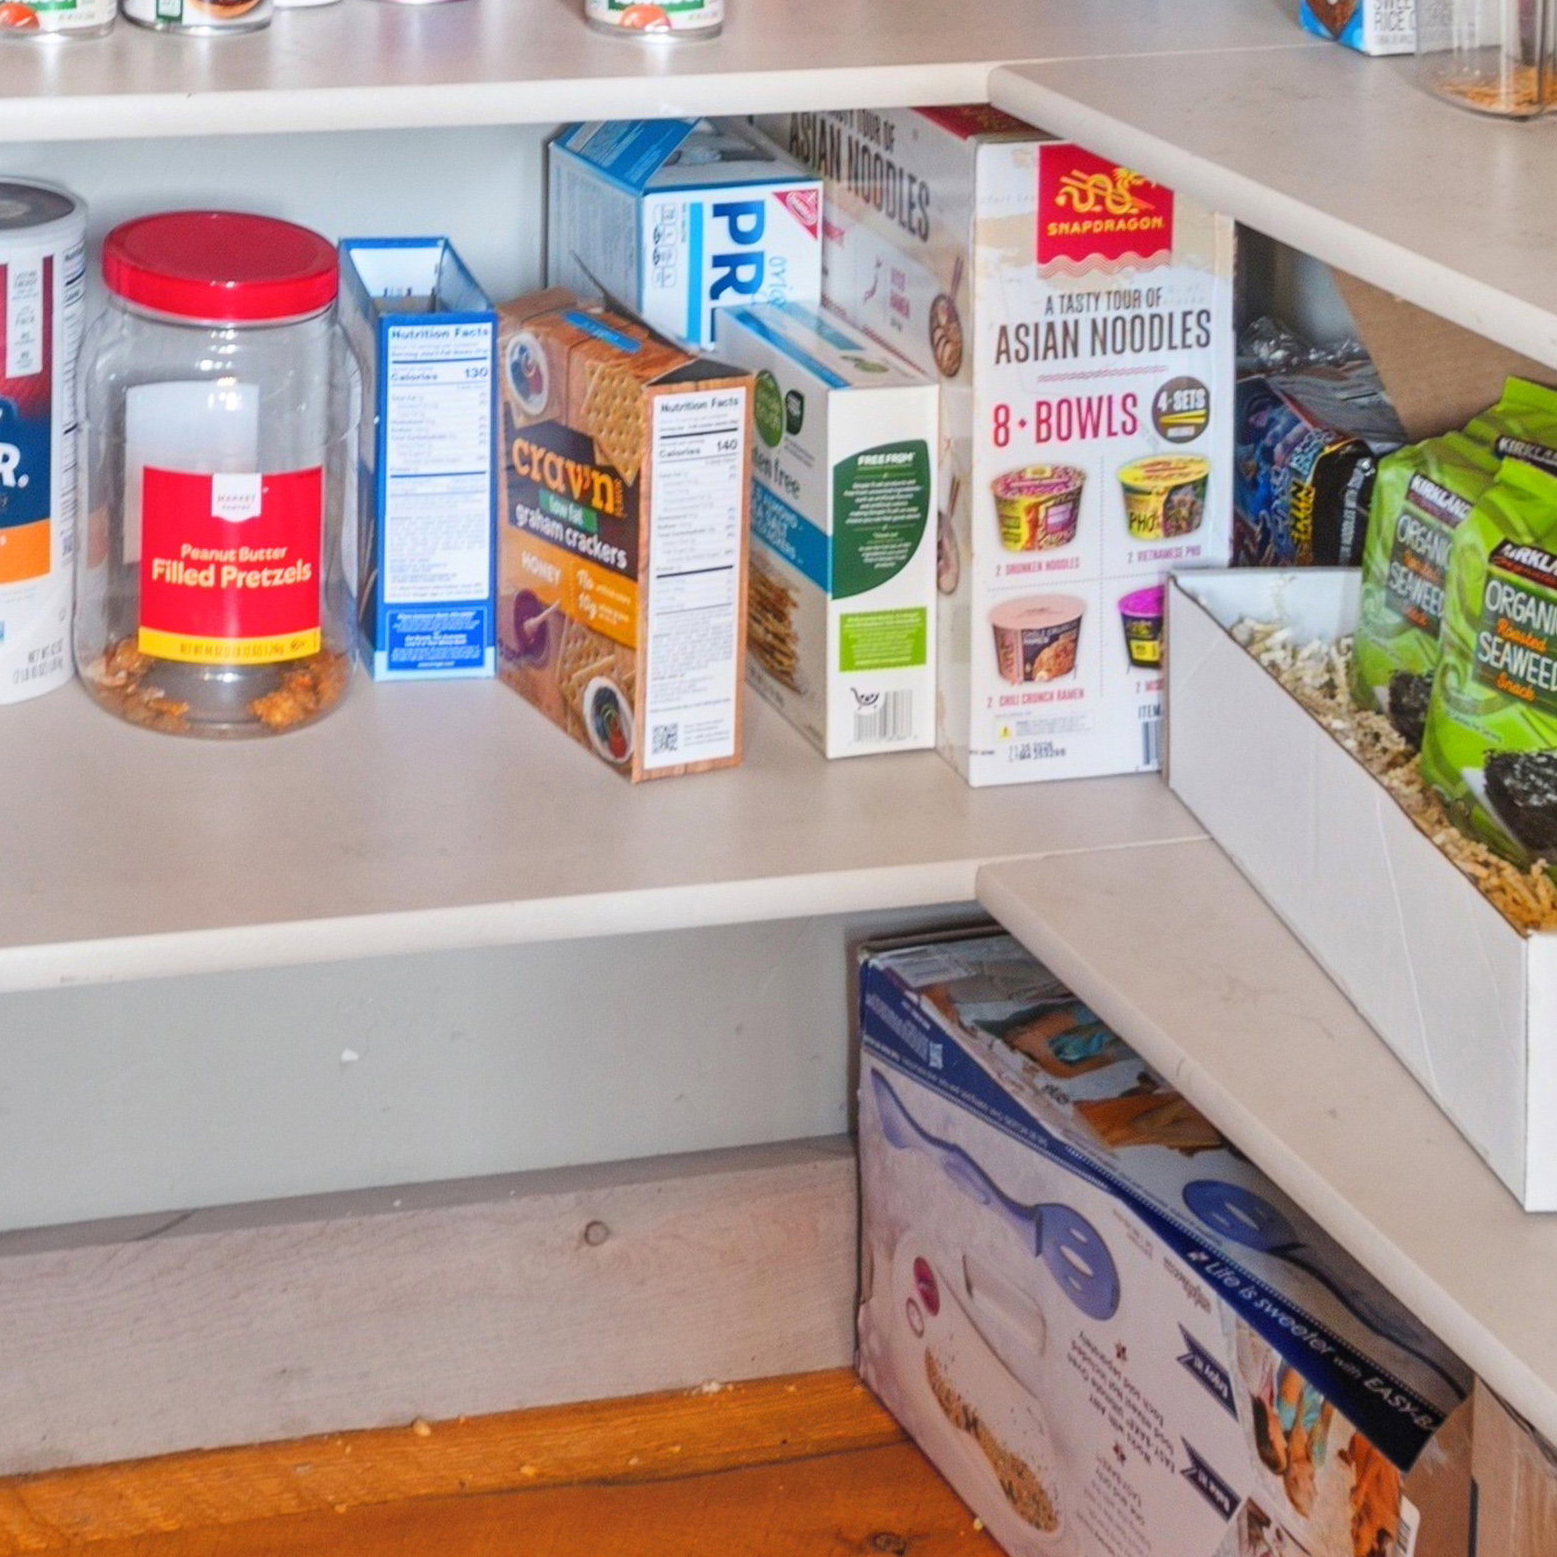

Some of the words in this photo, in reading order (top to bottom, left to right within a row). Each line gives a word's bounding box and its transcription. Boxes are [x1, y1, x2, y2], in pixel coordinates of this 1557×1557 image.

[788, 111, 842, 181] ASIAN
[848, 147, 931, 243] NOODLES
[1047, 216, 1164, 236] SNAPDRAGON
[1059, 292, 1101, 314] TASTY
[1106, 288, 1141, 311] TOUR
[1146, 287, 1164, 308] OF
[995, 318, 1079, 365] ASIAN
[1090, 309, 1211, 357] NOODLES
[464, 366, 488, 379] 130
[661, 397, 708, 413] Nutrition
[711, 395, 739, 409] Facts
[993, 403, 1010, 448] 8
[1035, 393, 1138, 444] BOWLS
[659, 446, 701, 459] Calories
[716, 437, 738, 451] 140
[549, 492, 566, 516] low
[568, 501, 582, 523] fat
[516, 503, 563, 545] graham
[564, 520, 627, 570] crackers
[181, 544, 236, 561] Peanut
[238, 544, 287, 562] Butter
[521, 550, 562, 585] HONEY
[1005, 561, 1041, 576] DRUNKEN
[1045, 557, 1080, 572] NOODLES
[1137, 547, 1182, 562] VIETNAMESE
[151, 558, 215, 589] Filled
[219, 559, 313, 589] Pretzels
[1495, 619, 1548, 654] Roasted
[999, 694, 1019, 707] CHILI
[1021, 691, 1054, 706] CRUNCH
[1056, 688, 1084, 703] RAMEN
[1204, 1259, 1240, 1291] Life
[1240, 1285, 1257, 1301] is
[1254, 1297, 1335, 1359] sweeter
[1333, 1356, 1362, 1379] with
